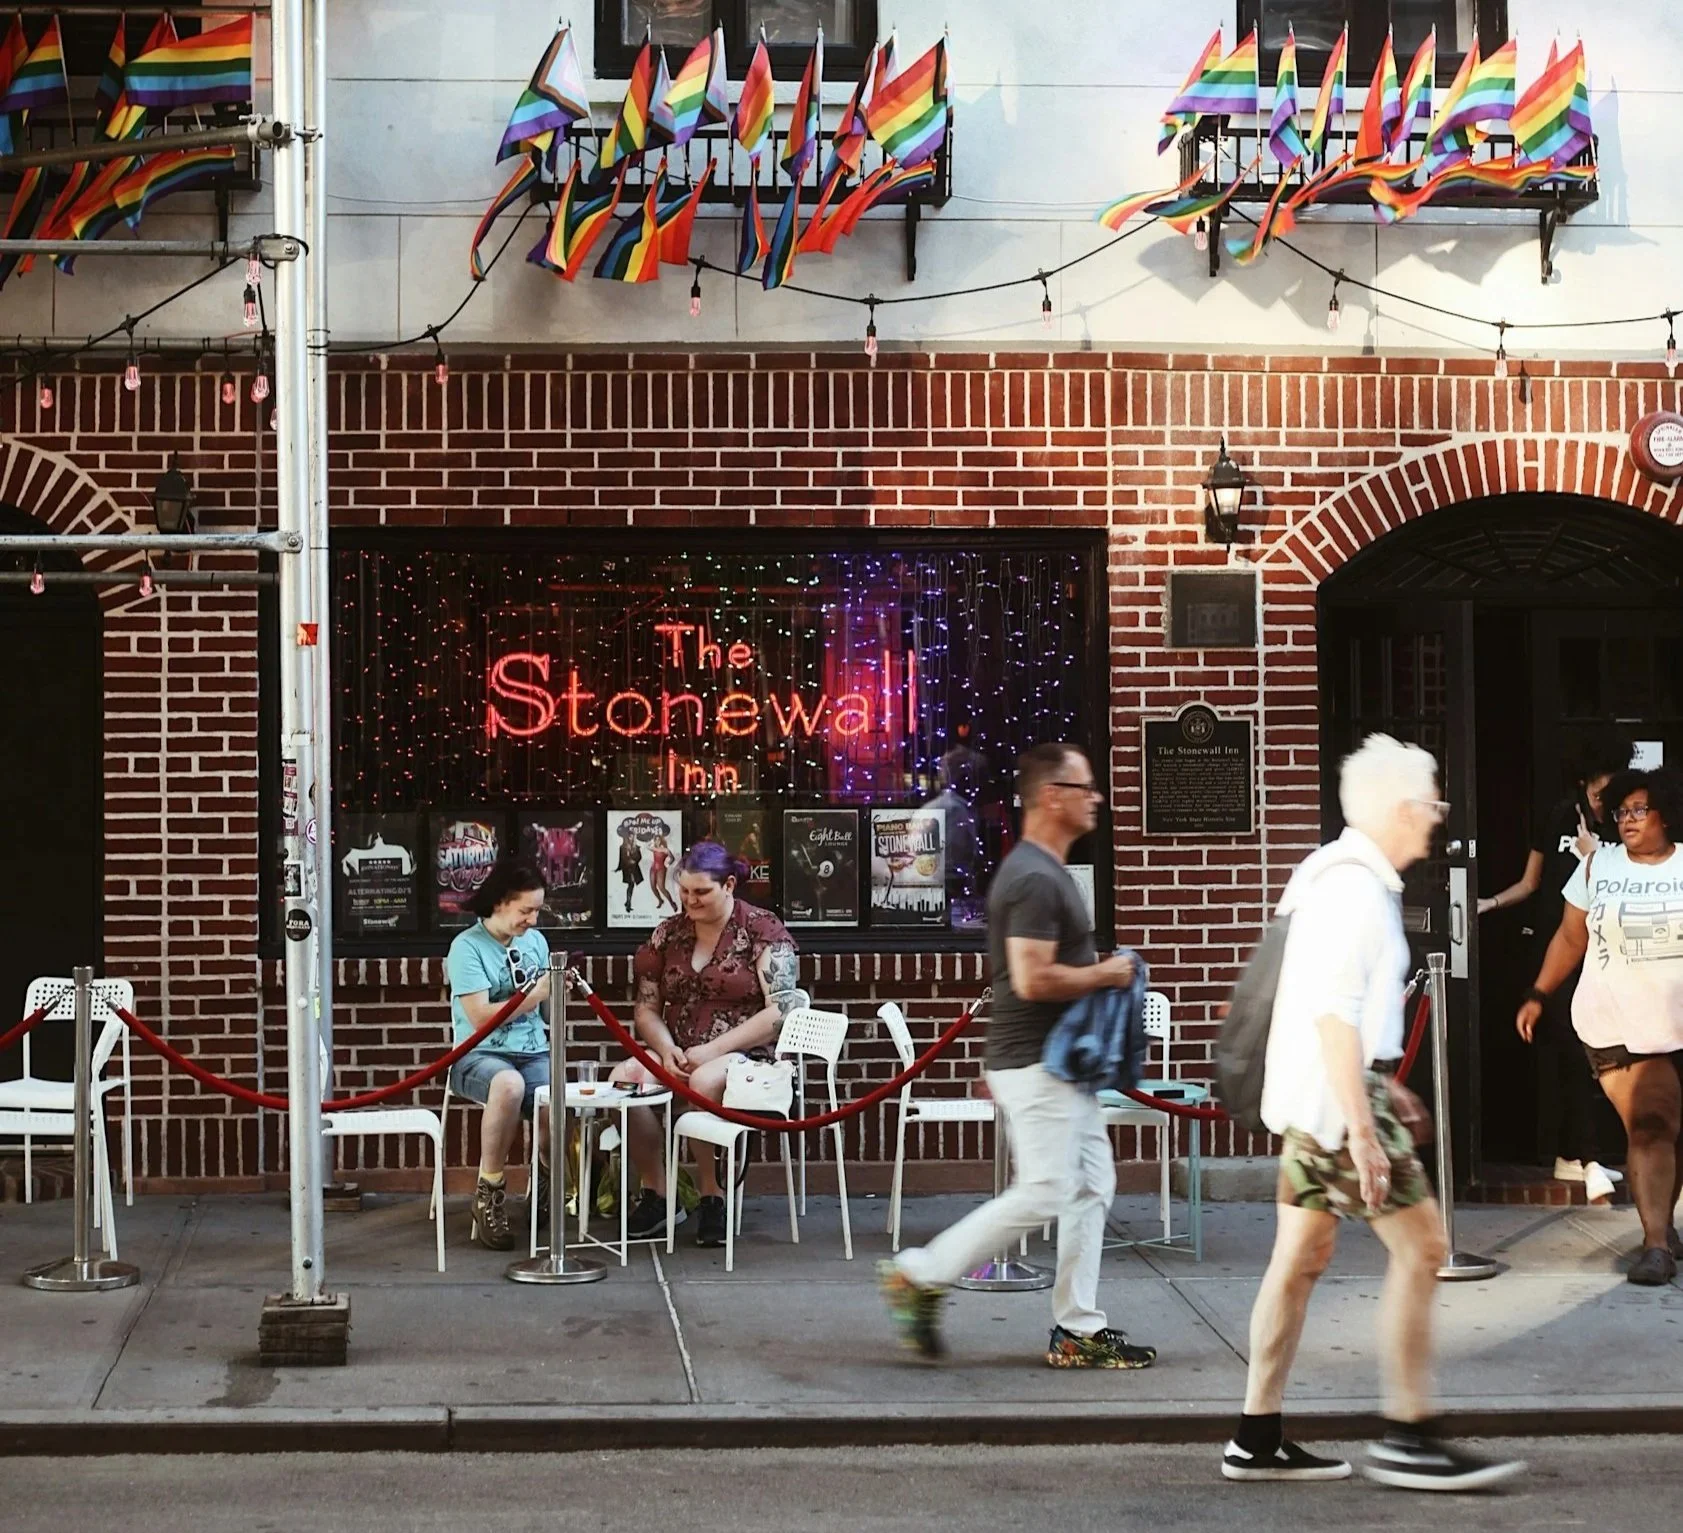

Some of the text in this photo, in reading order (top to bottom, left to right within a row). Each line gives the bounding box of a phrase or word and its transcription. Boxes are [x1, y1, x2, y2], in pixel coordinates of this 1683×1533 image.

[654, 624, 753, 669] The
[487, 650, 917, 739] Stonewall
[1158, 746, 1239, 755] The Stonewall Inn
[667, 748, 739, 794] Inn
[809, 827, 834, 846] Eight
[876, 823, 905, 831] PIANO
[437, 843, 499, 870] SATURDAY
[878, 833, 936, 856] STONEWALL
[348, 888, 397, 896] ALTERNATING
[1591, 901, 1610, 971] カメラ
